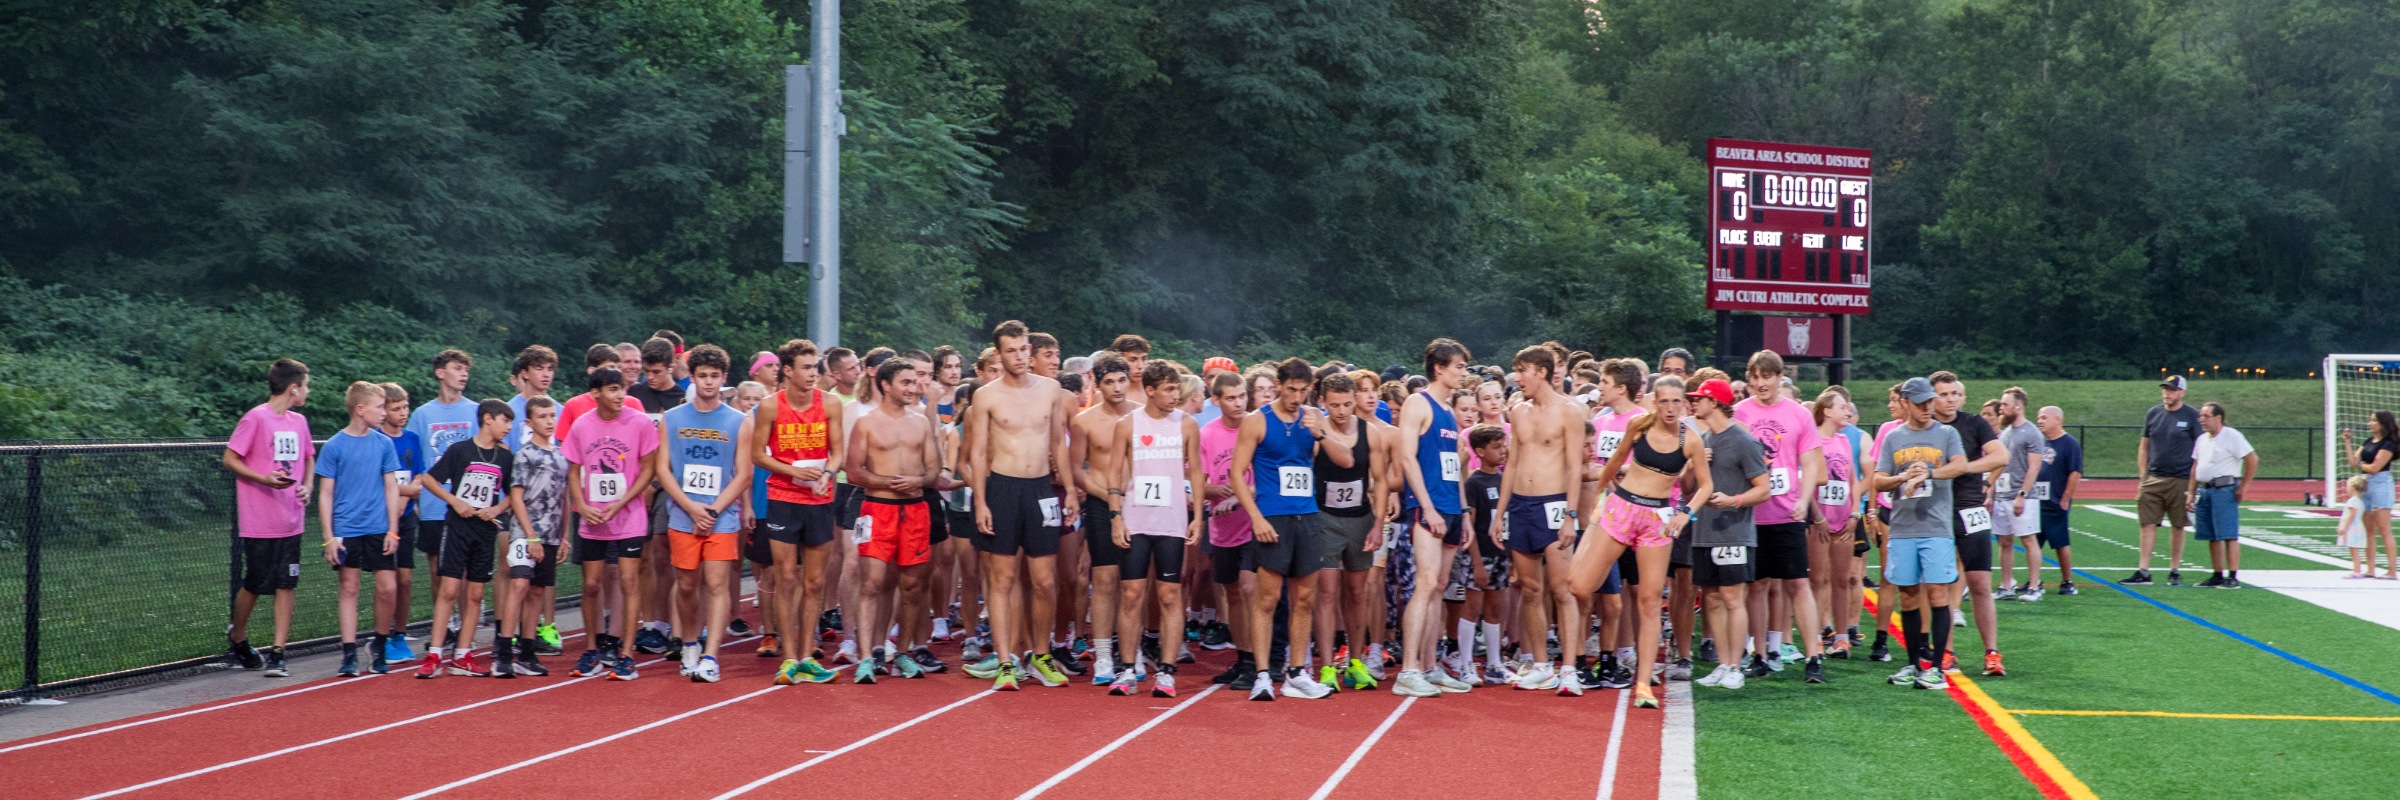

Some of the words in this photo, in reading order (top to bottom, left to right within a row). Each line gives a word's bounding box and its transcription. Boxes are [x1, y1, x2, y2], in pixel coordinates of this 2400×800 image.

[1716, 147, 1755, 160] BEAVER
[1756, 150, 1783, 162] AREA
[1784, 152, 1824, 165] SCHOOL
[1826, 155, 1870, 168] DISTRICT
[1733, 191, 1747, 221] 0
[1853, 198, 1867, 227] 0
[1720, 229, 1748, 245] PLACE
[1753, 231, 1782, 246] EVENT
[1715, 290, 1735, 302] JIM
[1736, 290, 1767, 303] CUTRI
[1769, 292, 1819, 305] ATHLETIC
[1821, 294, 1869, 307] COMPLEX
[678, 428, 730, 442] HOPEWELL
[279, 437, 296, 455] 191
[600, 480, 617, 496] 69
[689, 471, 714, 489] 261
[1286, 472, 1309, 490] 268
[461, 483, 489, 503] 249
[1144, 482, 1161, 499] 71
[1336, 487, 1354, 502] 32
[1824, 485, 1845, 500] 193
